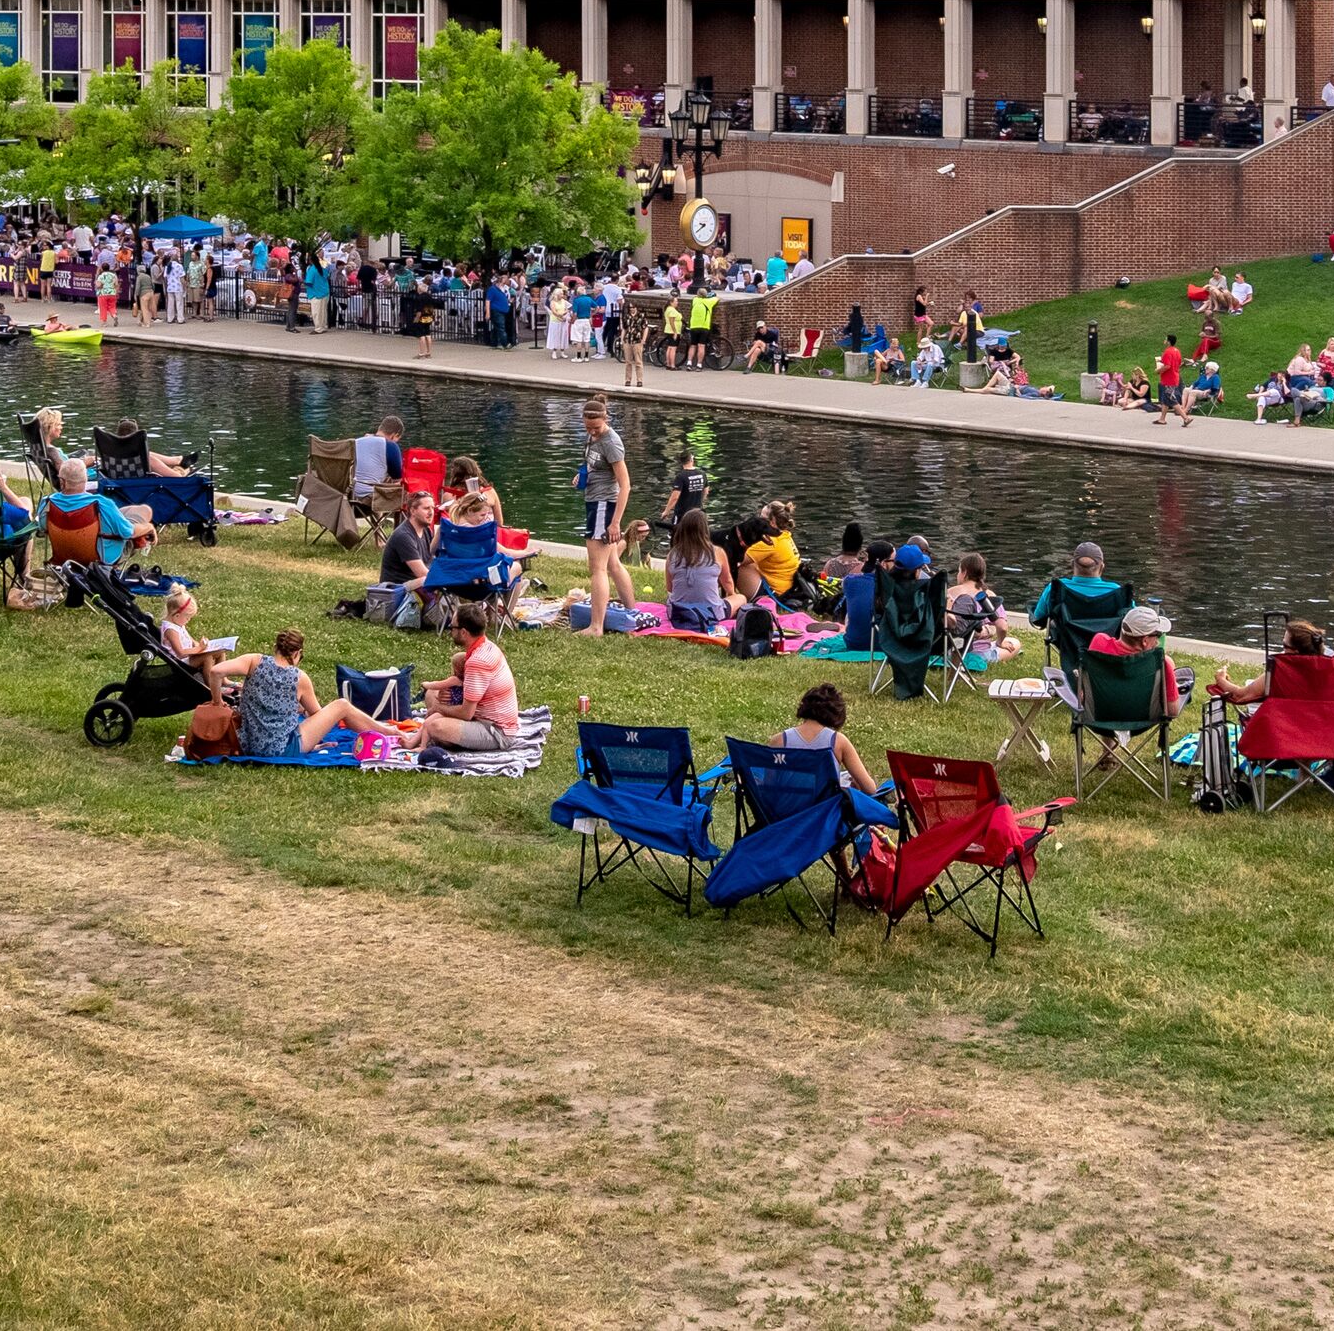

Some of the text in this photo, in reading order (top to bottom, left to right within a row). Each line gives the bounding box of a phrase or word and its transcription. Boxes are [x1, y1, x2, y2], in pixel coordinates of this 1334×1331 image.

[387, 32, 414, 40] HISTORY
[788, 233, 804, 241] VISIT
[784, 240, 807, 249] TODAY
